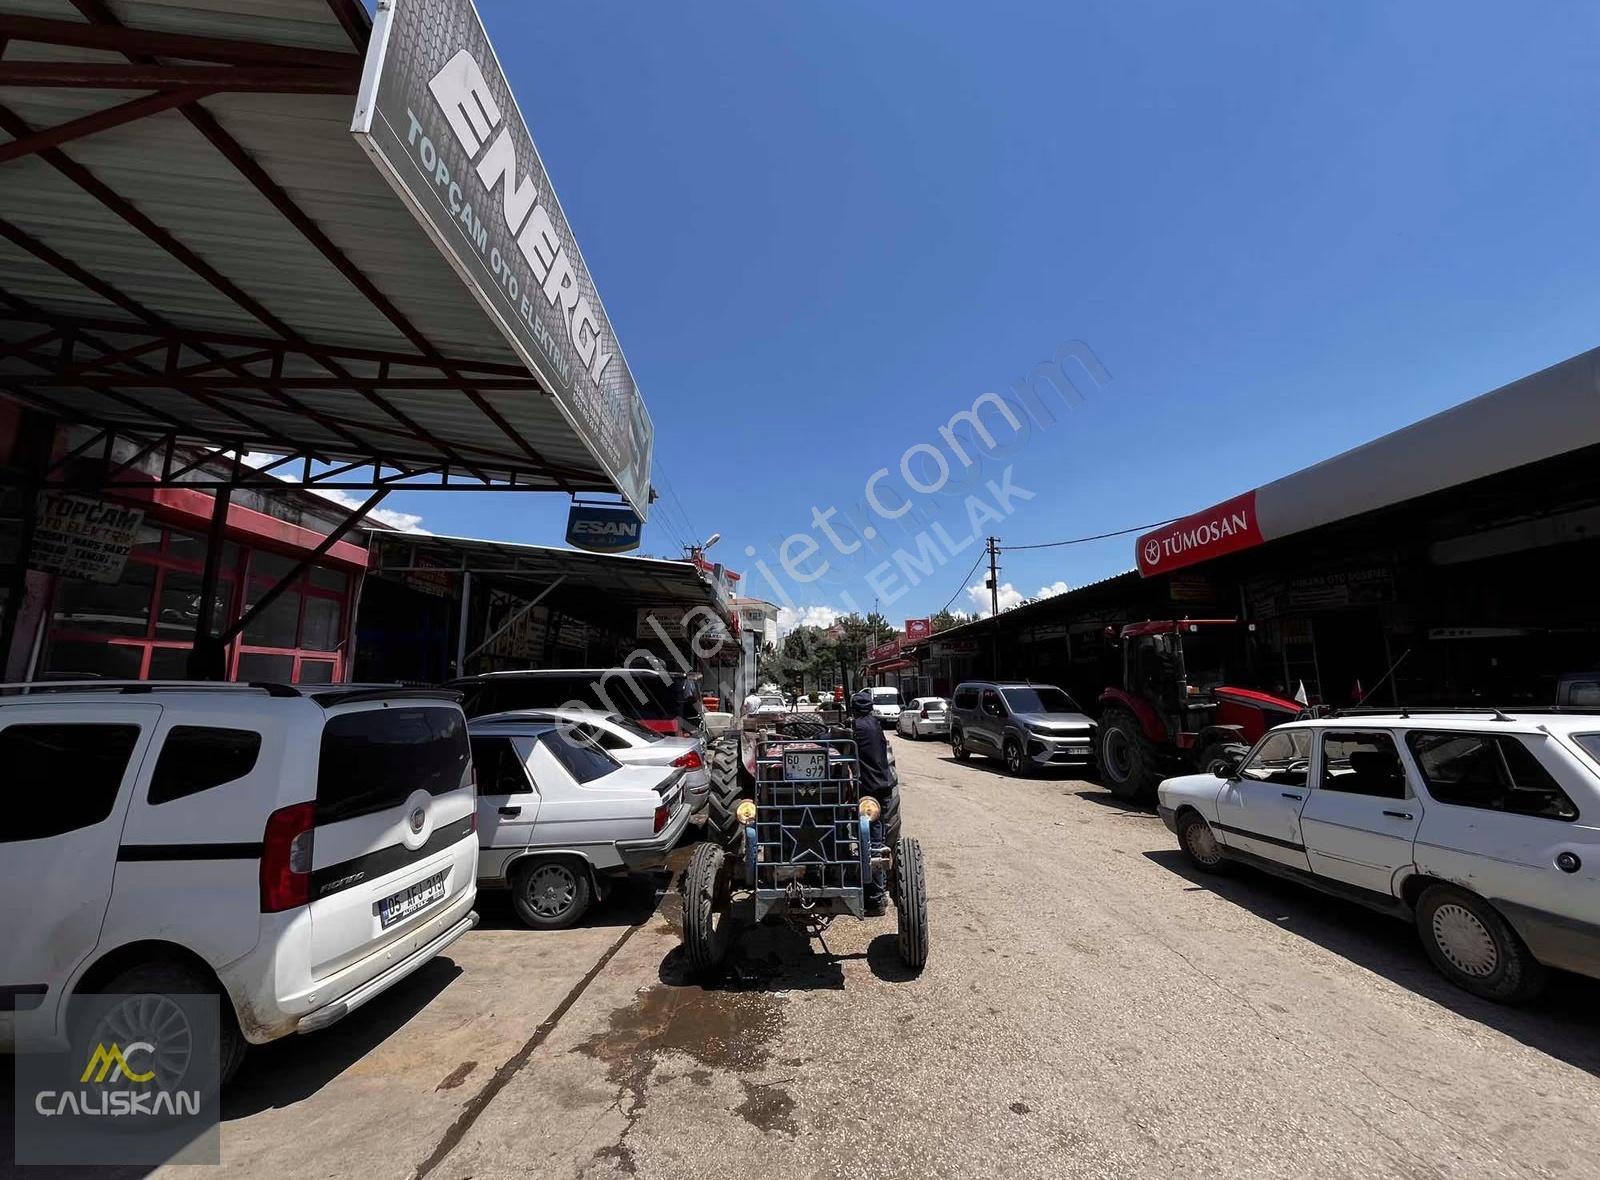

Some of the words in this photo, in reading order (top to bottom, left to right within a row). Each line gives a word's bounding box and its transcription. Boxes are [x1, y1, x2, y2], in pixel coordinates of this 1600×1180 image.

[406, 107, 488, 255] TOPÇAM
[490, 247, 519, 301] OTO
[428, 49, 613, 387] ENERGY
[571, 520, 637, 537] ESAN
[1162, 510, 1248, 557] TÜMOSAN
[787, 755, 800, 765] 60
[805, 765, 824, 778] 977
[388, 895, 402, 915] 05
[407, 884, 424, 907] AFJ
[428, 874, 443, 896] 313
